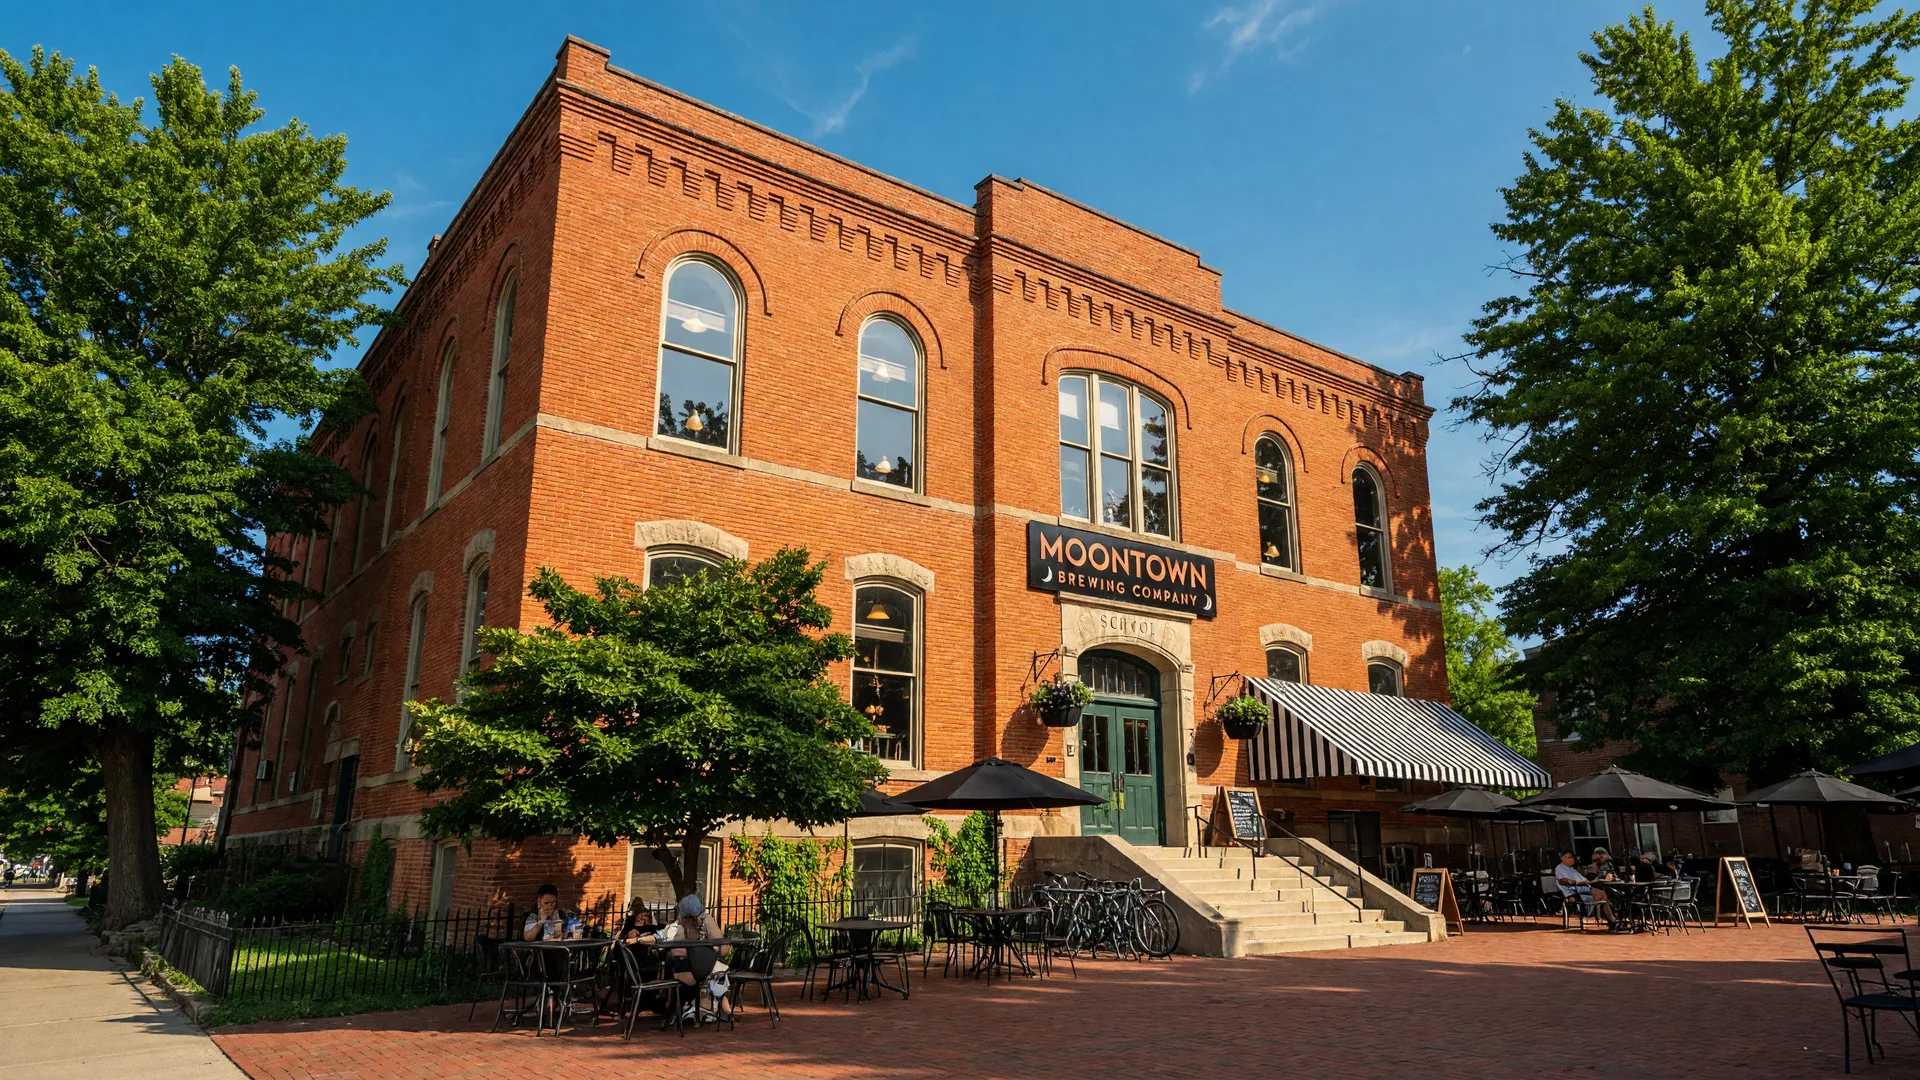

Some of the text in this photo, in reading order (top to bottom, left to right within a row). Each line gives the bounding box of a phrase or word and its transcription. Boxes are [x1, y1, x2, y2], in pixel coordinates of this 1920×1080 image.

[1040, 531, 1207, 590] MOONTOWN
[1058, 570, 1197, 606] BREWING COMPANY
